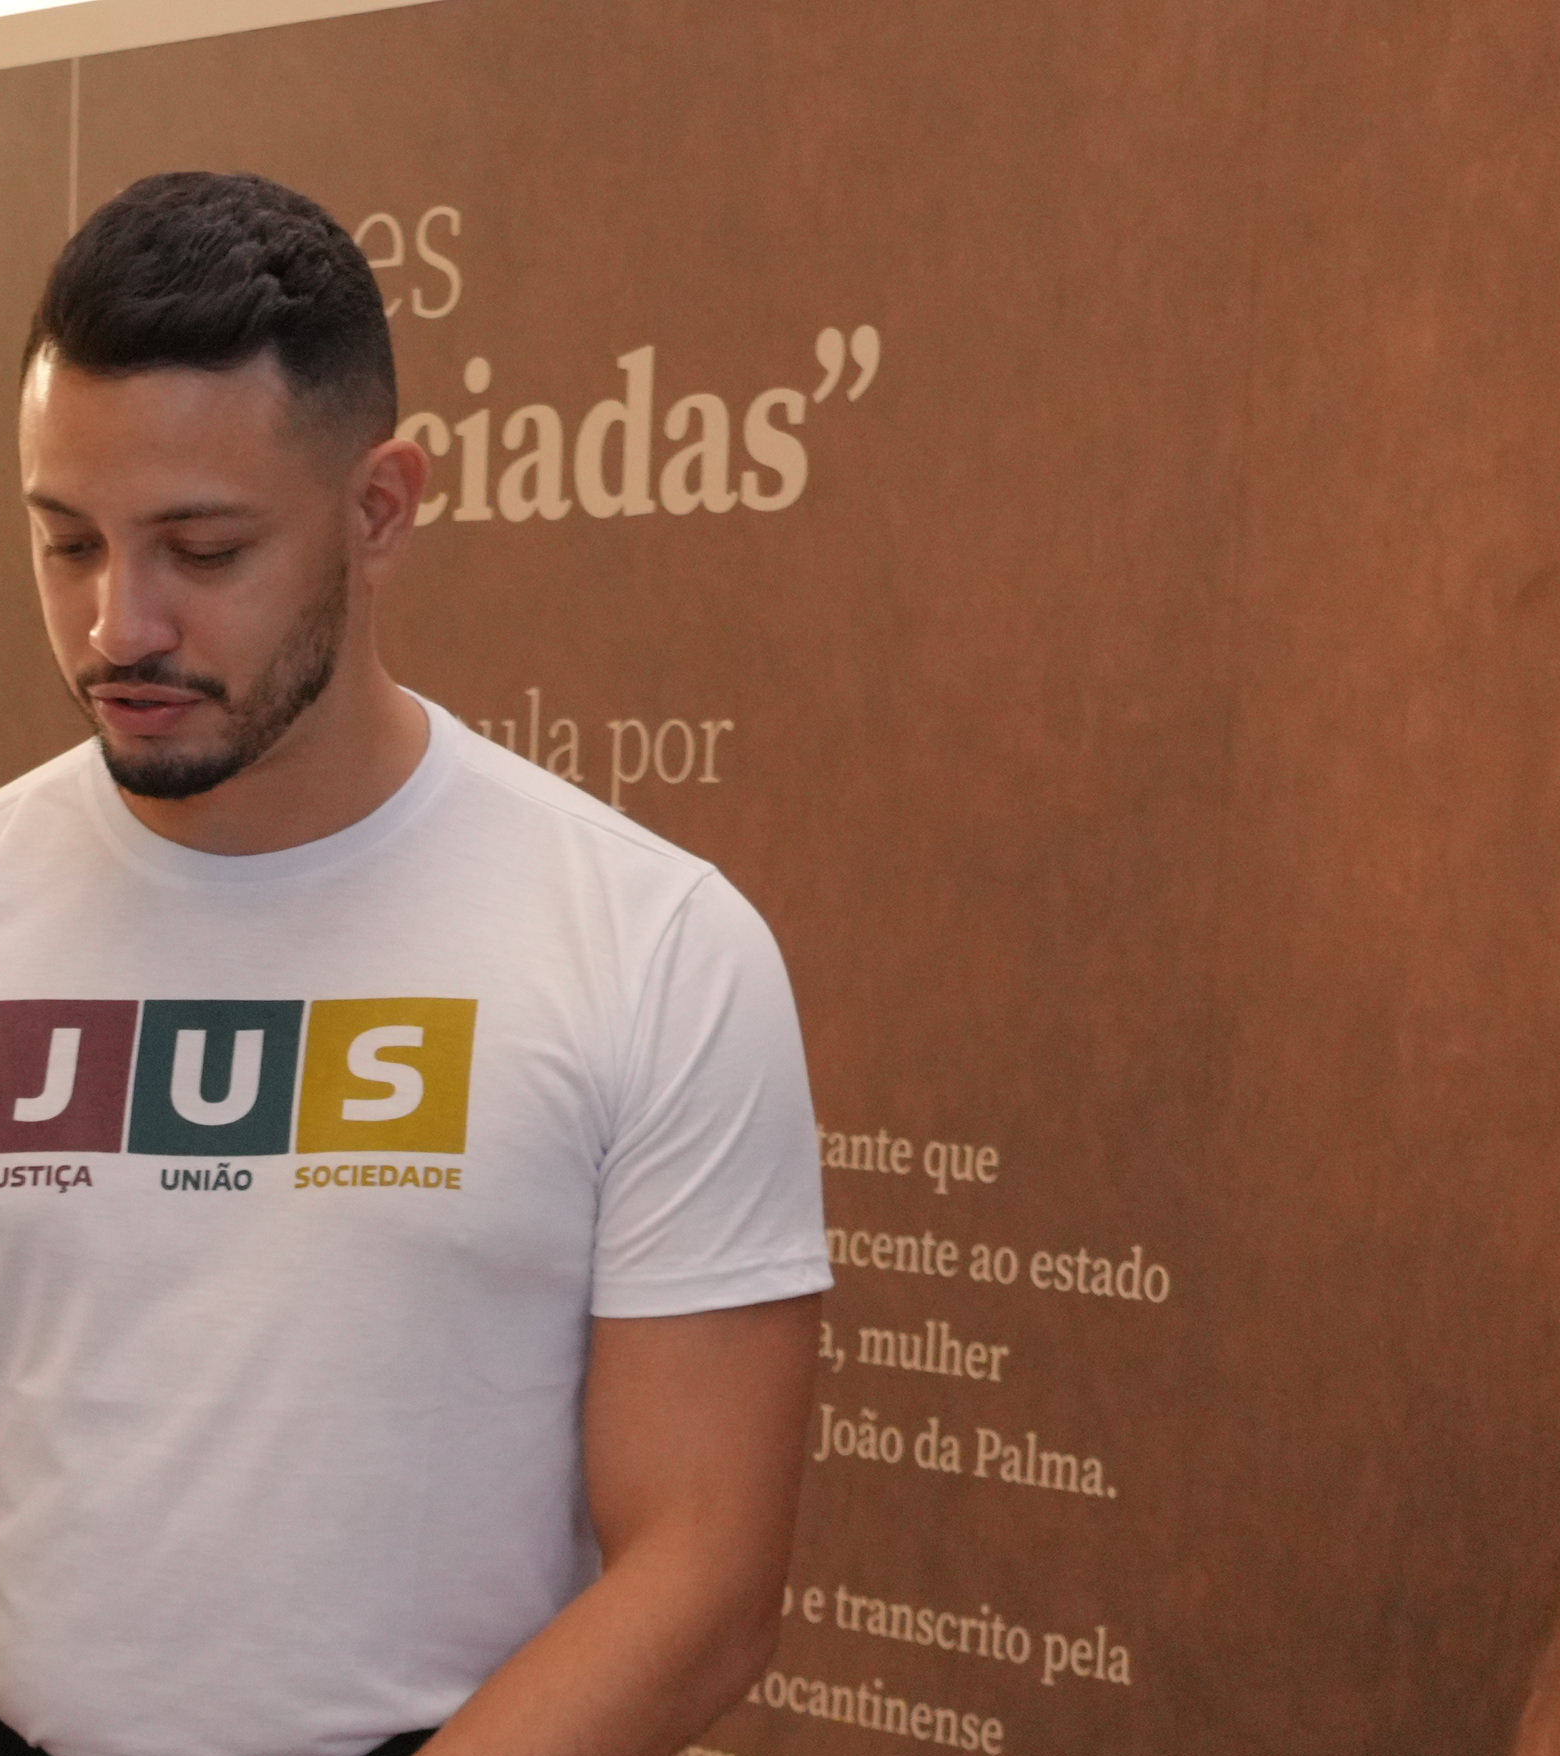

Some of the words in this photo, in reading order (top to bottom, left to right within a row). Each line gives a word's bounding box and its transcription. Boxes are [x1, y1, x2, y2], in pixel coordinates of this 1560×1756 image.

[355, 205, 463, 319] es
[607, 716, 735, 812] por
[12, 1025, 425, 1126] JUS
[160, 1162, 254, 1192] UNIÃO
[294, 1164, 463, 1191] SOCIEDADE
[818, 1122, 912, 1175] tante
[923, 1138, 1000, 1195] que
[825, 1226, 959, 1278] ncente
[969, 1241, 1019, 1284] ao
[1029, 1245, 1171, 1303] estado
[857, 1319, 1010, 1382] mulher
[813, 1403, 905, 1463] João
[913, 1417, 962, 1475] da
[973, 1427, 1119, 1500] Palma.
[802, 1586, 826, 1625] e
[834, 1584, 1032, 1665] transcrito
[1040, 1625, 1132, 1687] pela
